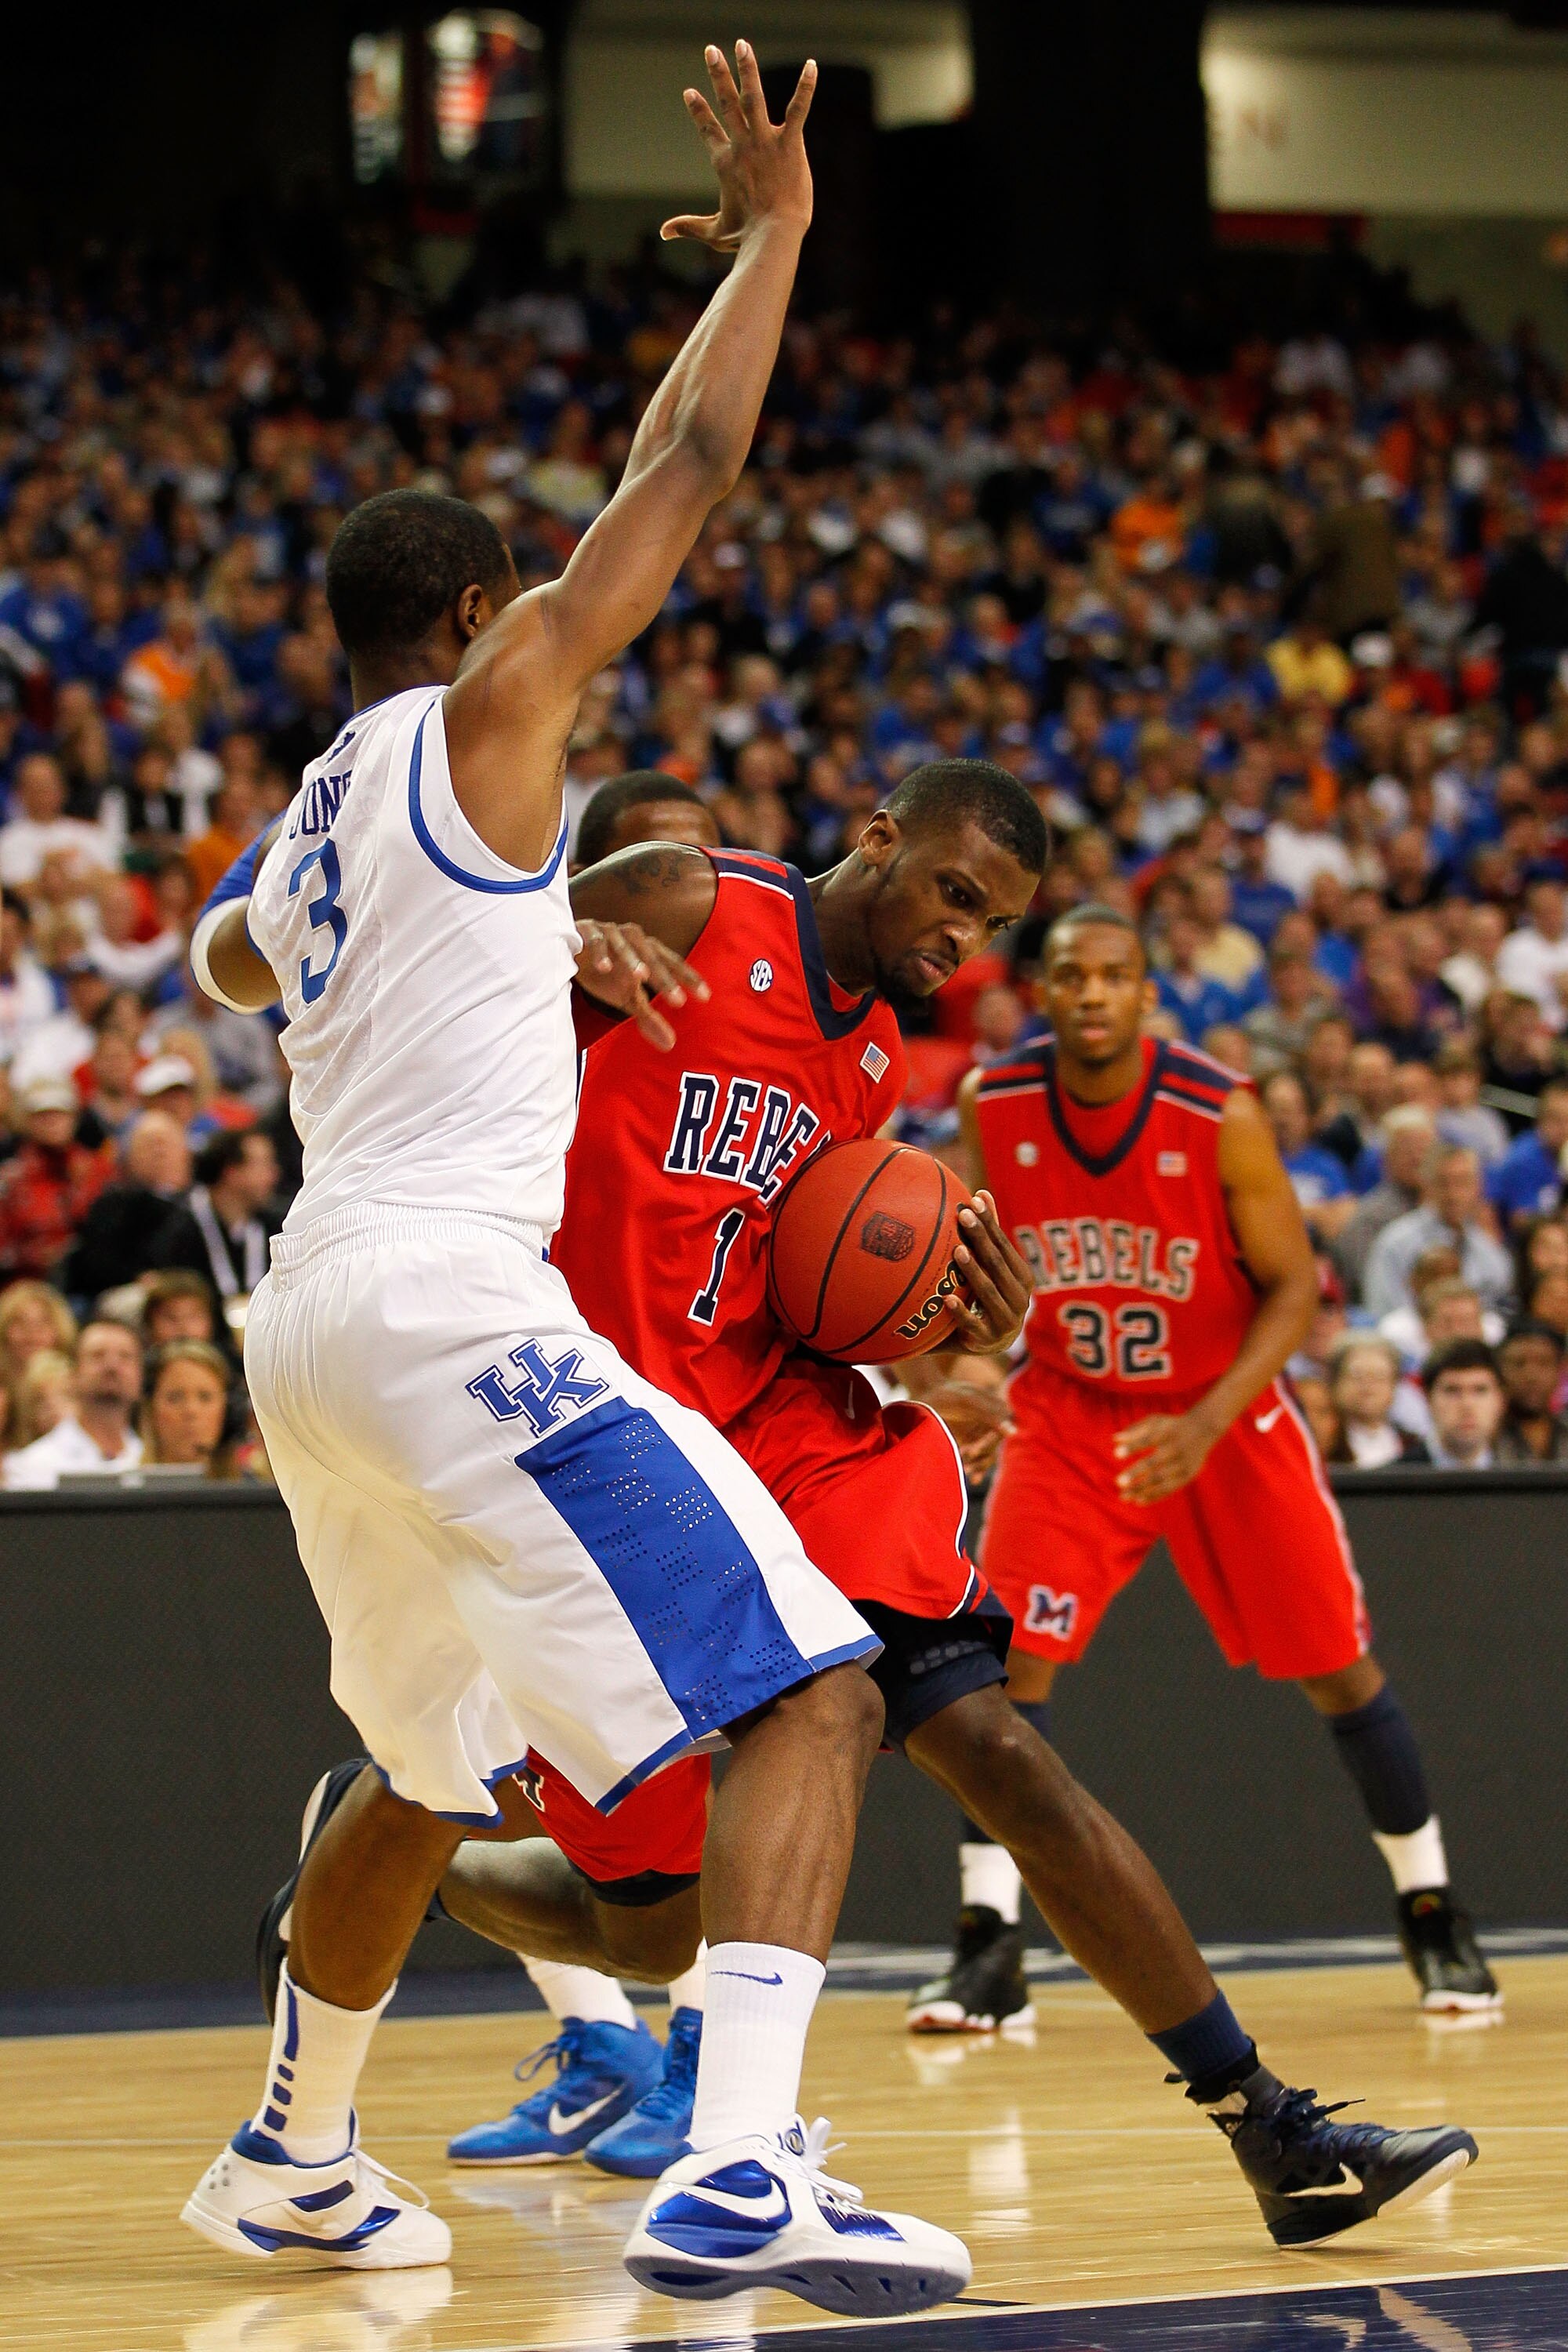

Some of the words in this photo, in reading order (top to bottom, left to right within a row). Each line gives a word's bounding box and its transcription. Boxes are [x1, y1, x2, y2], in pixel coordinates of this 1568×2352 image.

[288, 838, 349, 1007] 3
[749, 958, 774, 993] SEC
[688, 1207, 746, 1327] 1
[465, 1338, 609, 1439] UK
[1058, 1300, 1173, 1382] 32
